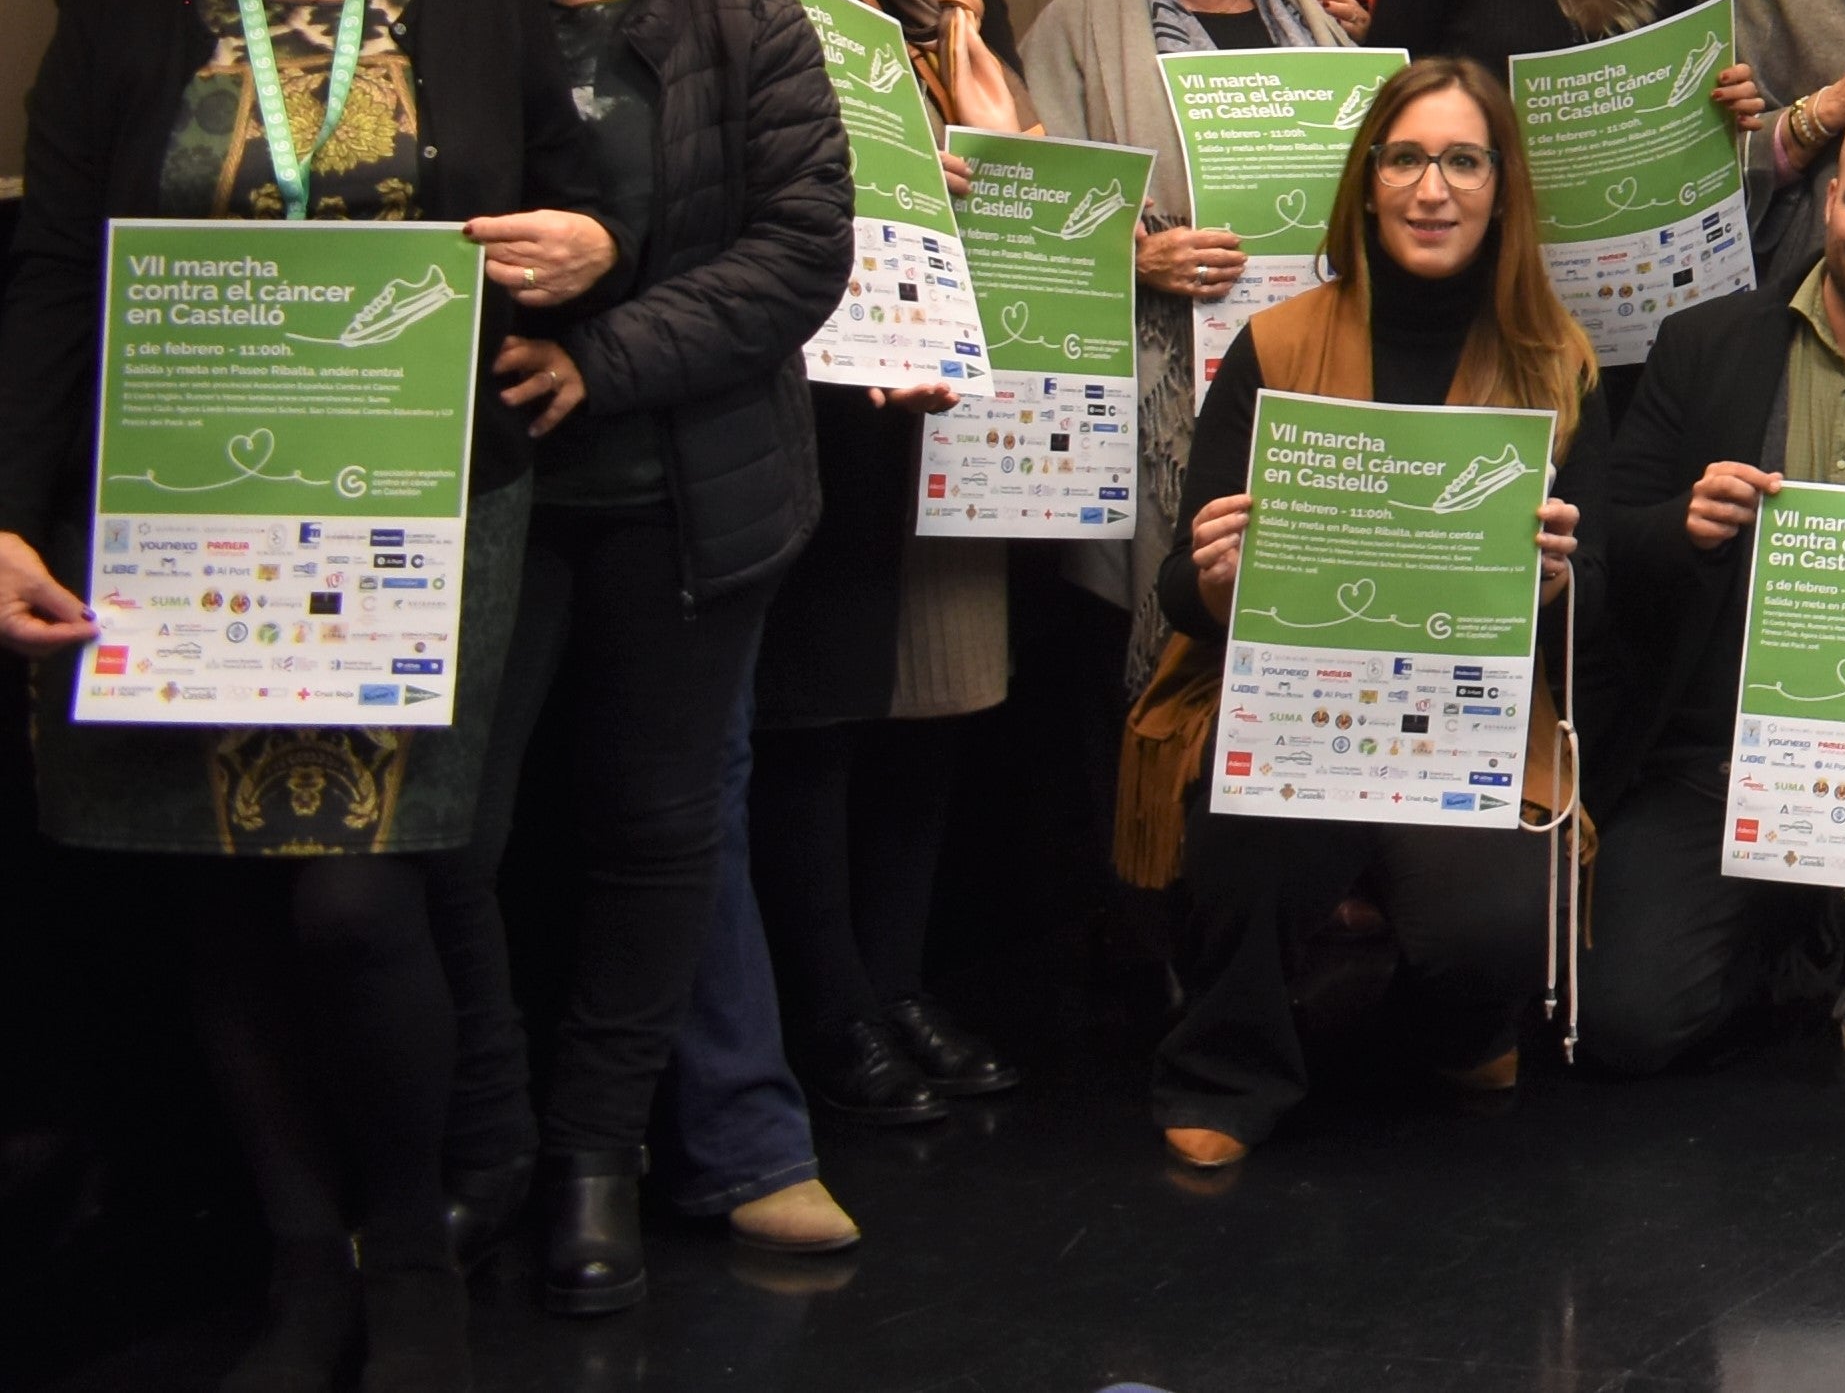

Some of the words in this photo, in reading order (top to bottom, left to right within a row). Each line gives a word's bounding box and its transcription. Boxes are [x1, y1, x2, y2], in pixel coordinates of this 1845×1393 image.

[129, 256, 171, 276] VII
[173, 256, 278, 278] marcha
[127, 275, 225, 304] contra
[226, 276, 261, 302] el
[261, 276, 354, 305] cáncer
[126, 309, 161, 324] en
[168, 299, 284, 326] Castelló
[1271, 423, 1297, 442] VII
[1303, 431, 1385, 452] marcha
[1267, 448, 1336, 470] contra
[1343, 448, 1372, 471] el
[1370, 450, 1446, 475] cáncer
[1264, 469, 1291, 483] en
[1297, 468, 1388, 493] Castelló
[1289, 499, 1339, 515] febrero
[1350, 504, 1395, 520] 11:00h.
[1775, 510, 1799, 527] VII
[1771, 533, 1836, 552] contra
[1769, 552, 1794, 566] en
[1269, 712, 1303, 722] SUMA
